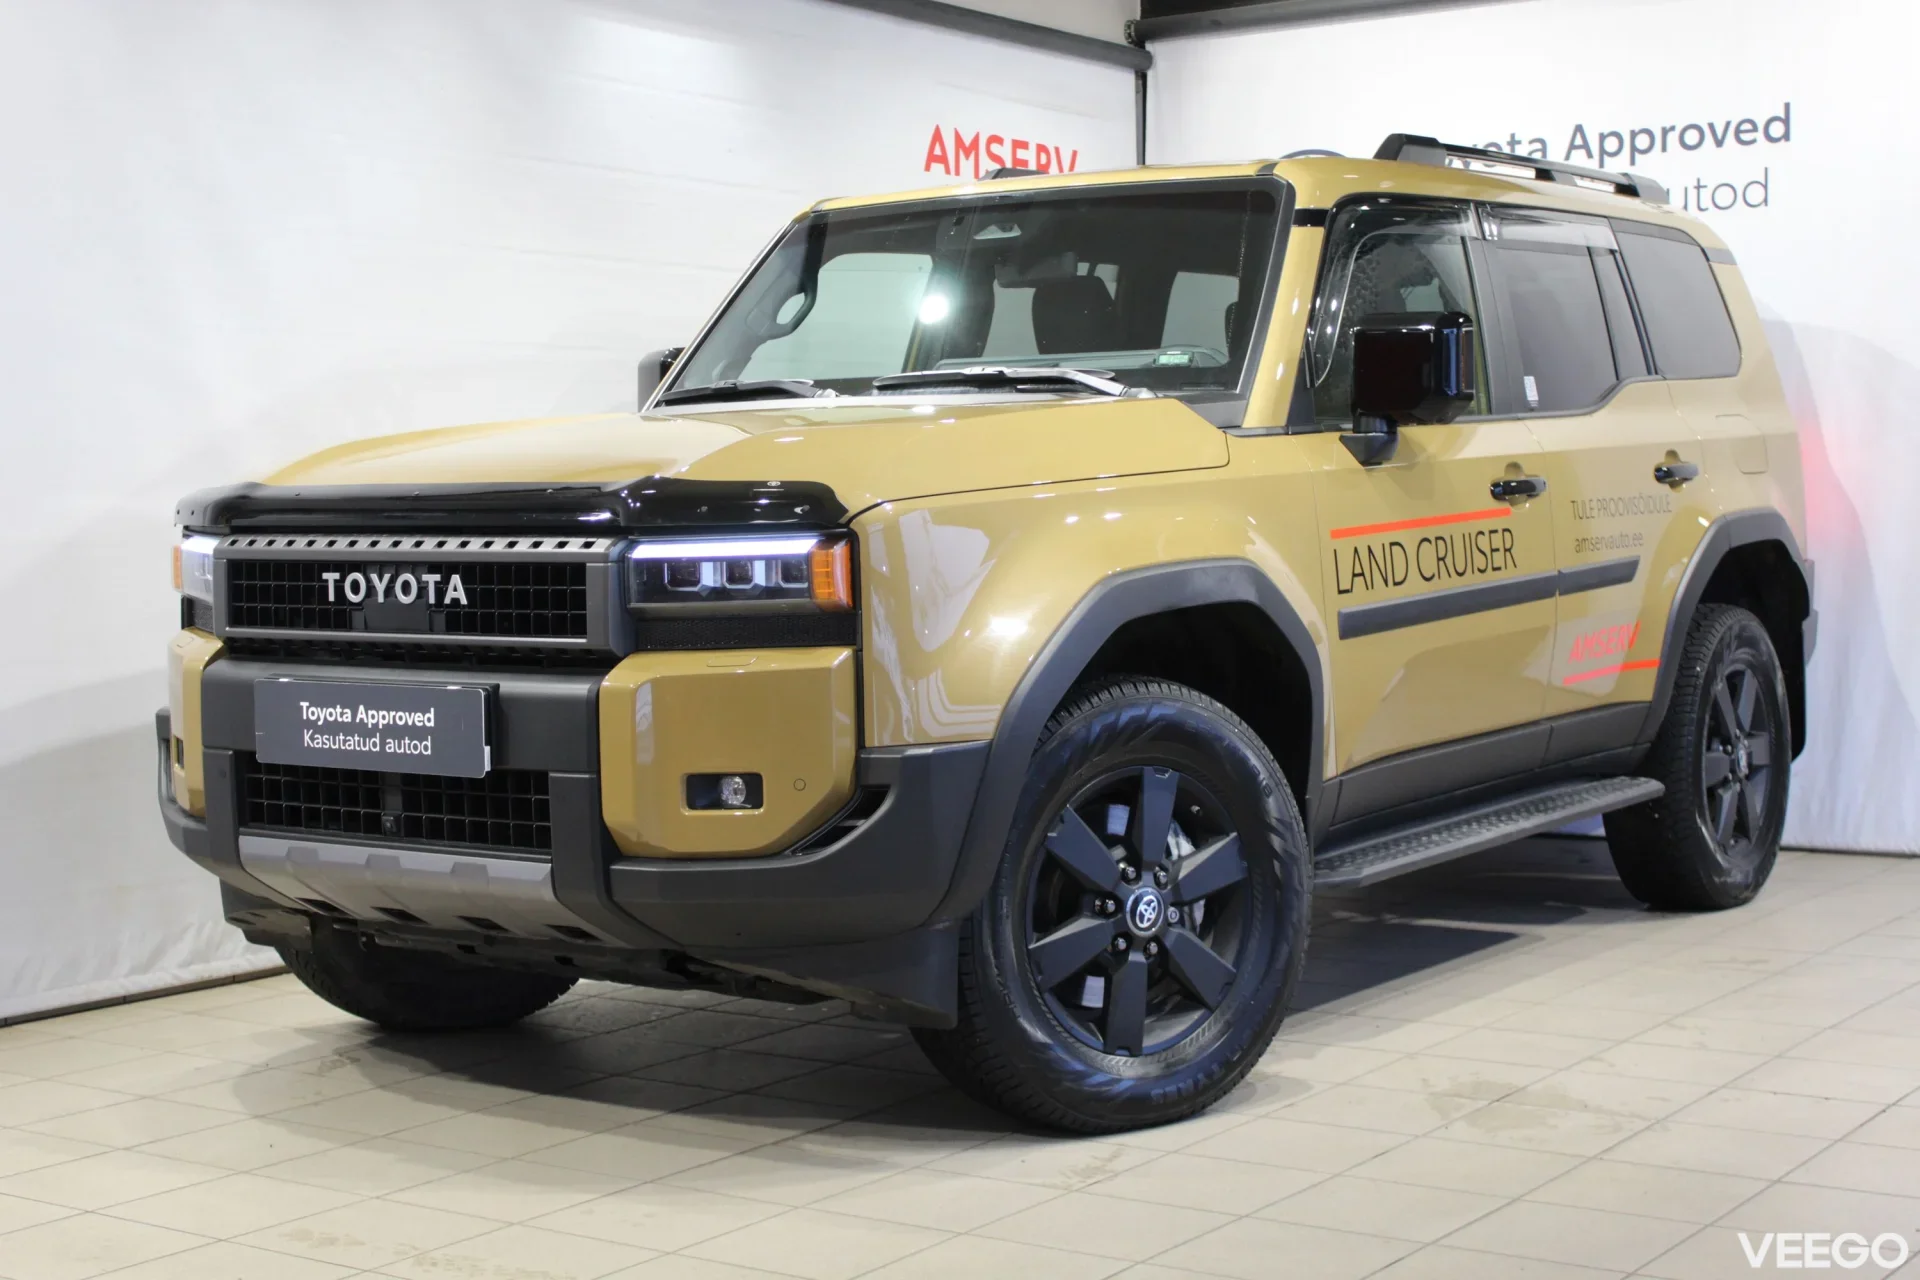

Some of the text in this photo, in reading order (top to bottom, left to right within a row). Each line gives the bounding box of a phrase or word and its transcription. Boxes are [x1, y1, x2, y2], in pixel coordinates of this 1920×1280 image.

[923, 123, 1079, 180] AMSERV
[1563, 101, 1792, 168] Approved
[1665, 166, 1769, 213] utod
[1570, 498, 1596, 520] TULE
[1332, 527, 1518, 595] LAND CRUISER
[1574, 531, 1645, 554] amservauto.ee
[321, 572, 468, 606] TOYOTA
[1567, 618, 1642, 665] AMSERV
[299, 701, 436, 729] Toyota Approved
[303, 728, 432, 755] Kasutatud autod
